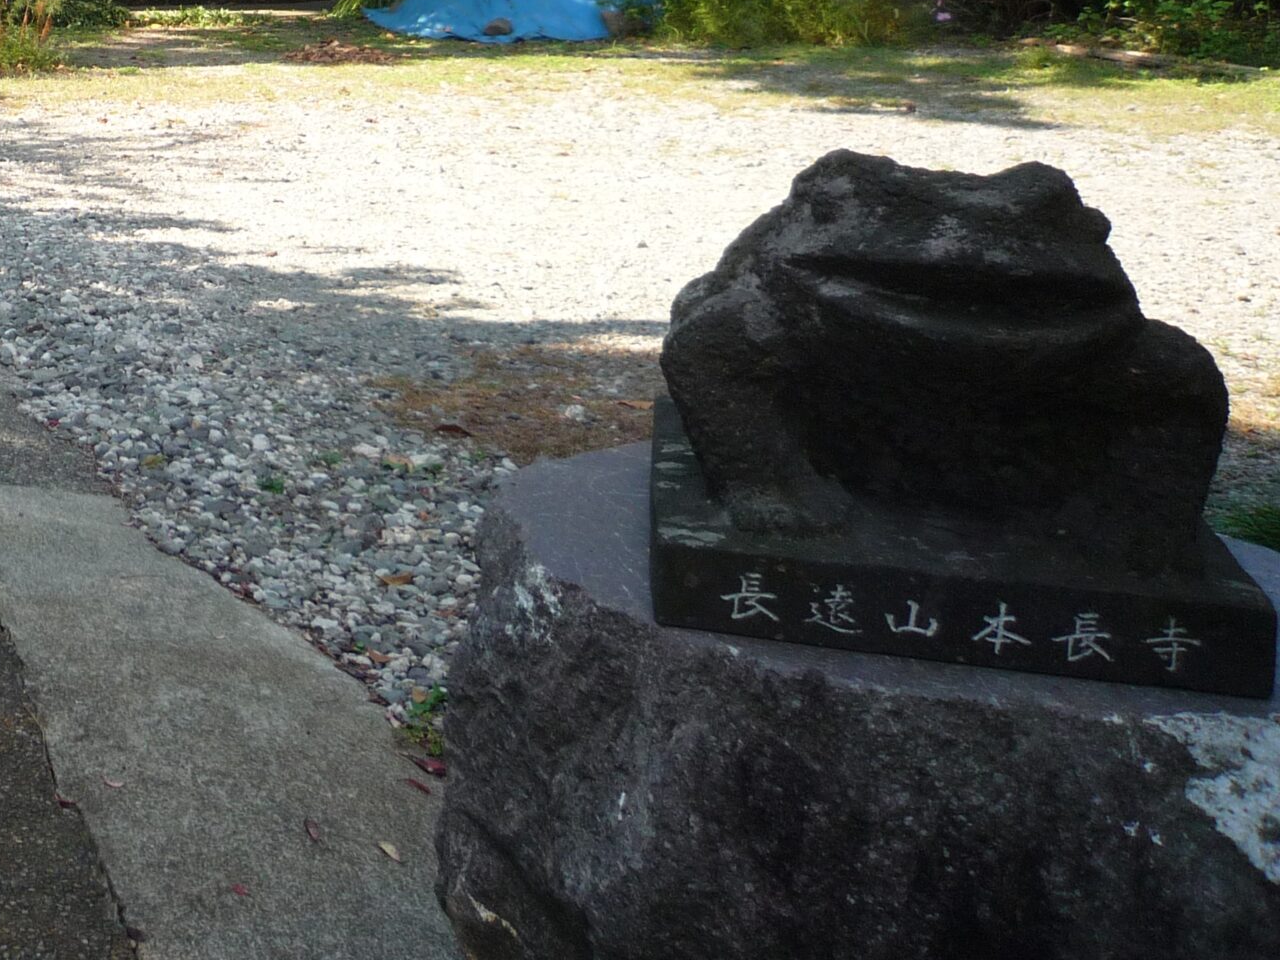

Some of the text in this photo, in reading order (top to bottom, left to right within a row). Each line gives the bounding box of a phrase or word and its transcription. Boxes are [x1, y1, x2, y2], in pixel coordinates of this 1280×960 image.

[720, 572, 1201, 672] 長遠山本長寺
